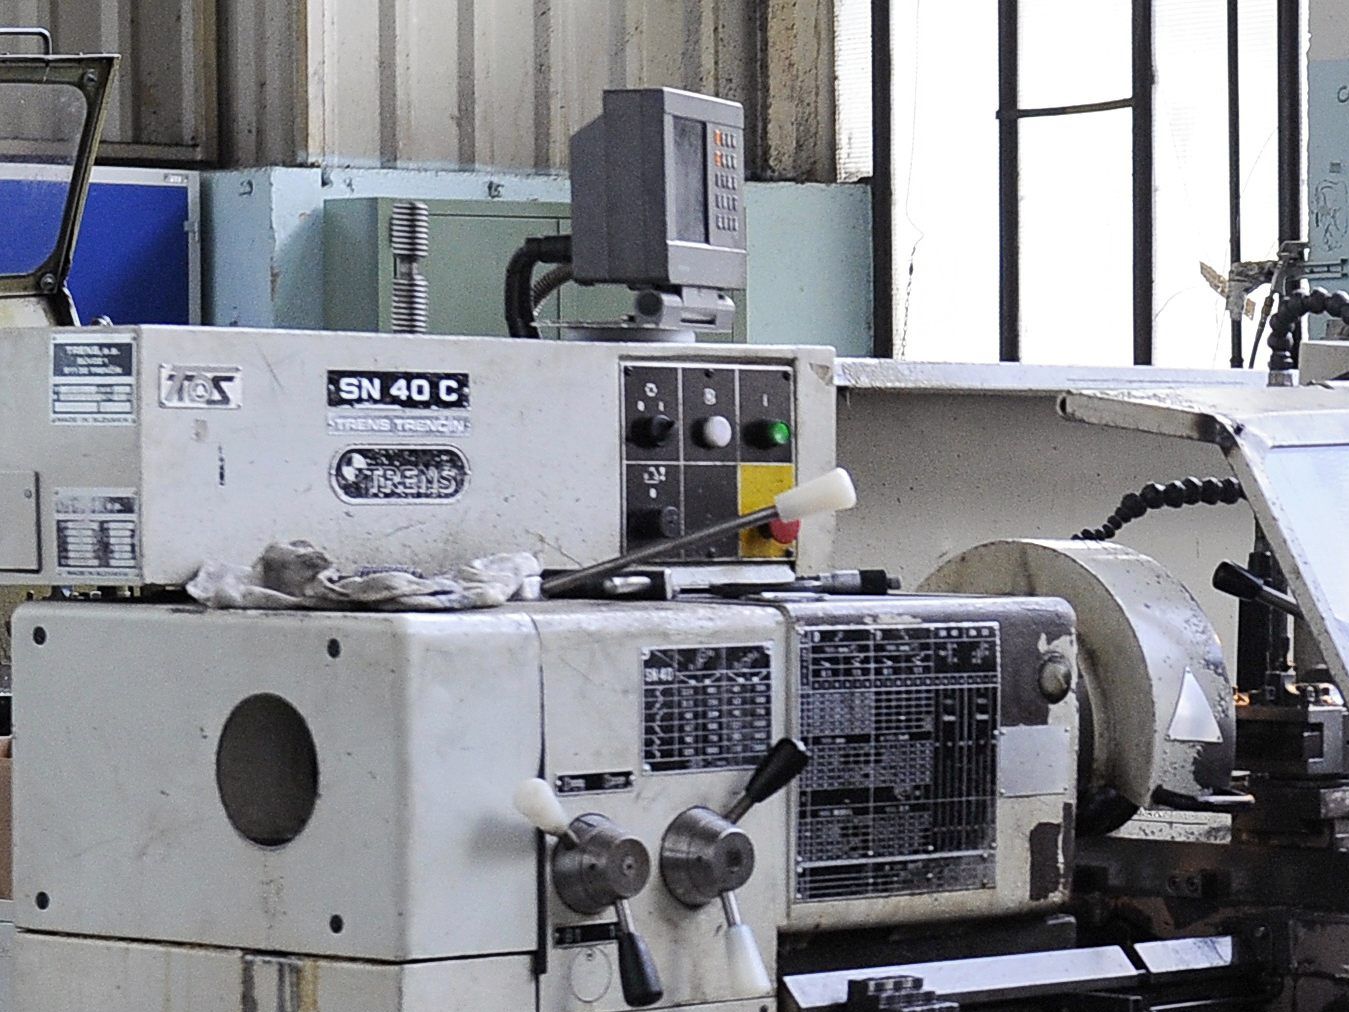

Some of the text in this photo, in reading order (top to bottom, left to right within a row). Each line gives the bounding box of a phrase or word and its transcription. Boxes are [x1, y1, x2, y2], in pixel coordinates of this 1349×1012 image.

[339, 377, 459, 401] SN 40 C
[335, 418, 390, 430] TRENS
[365, 465, 457, 494] TRENS
